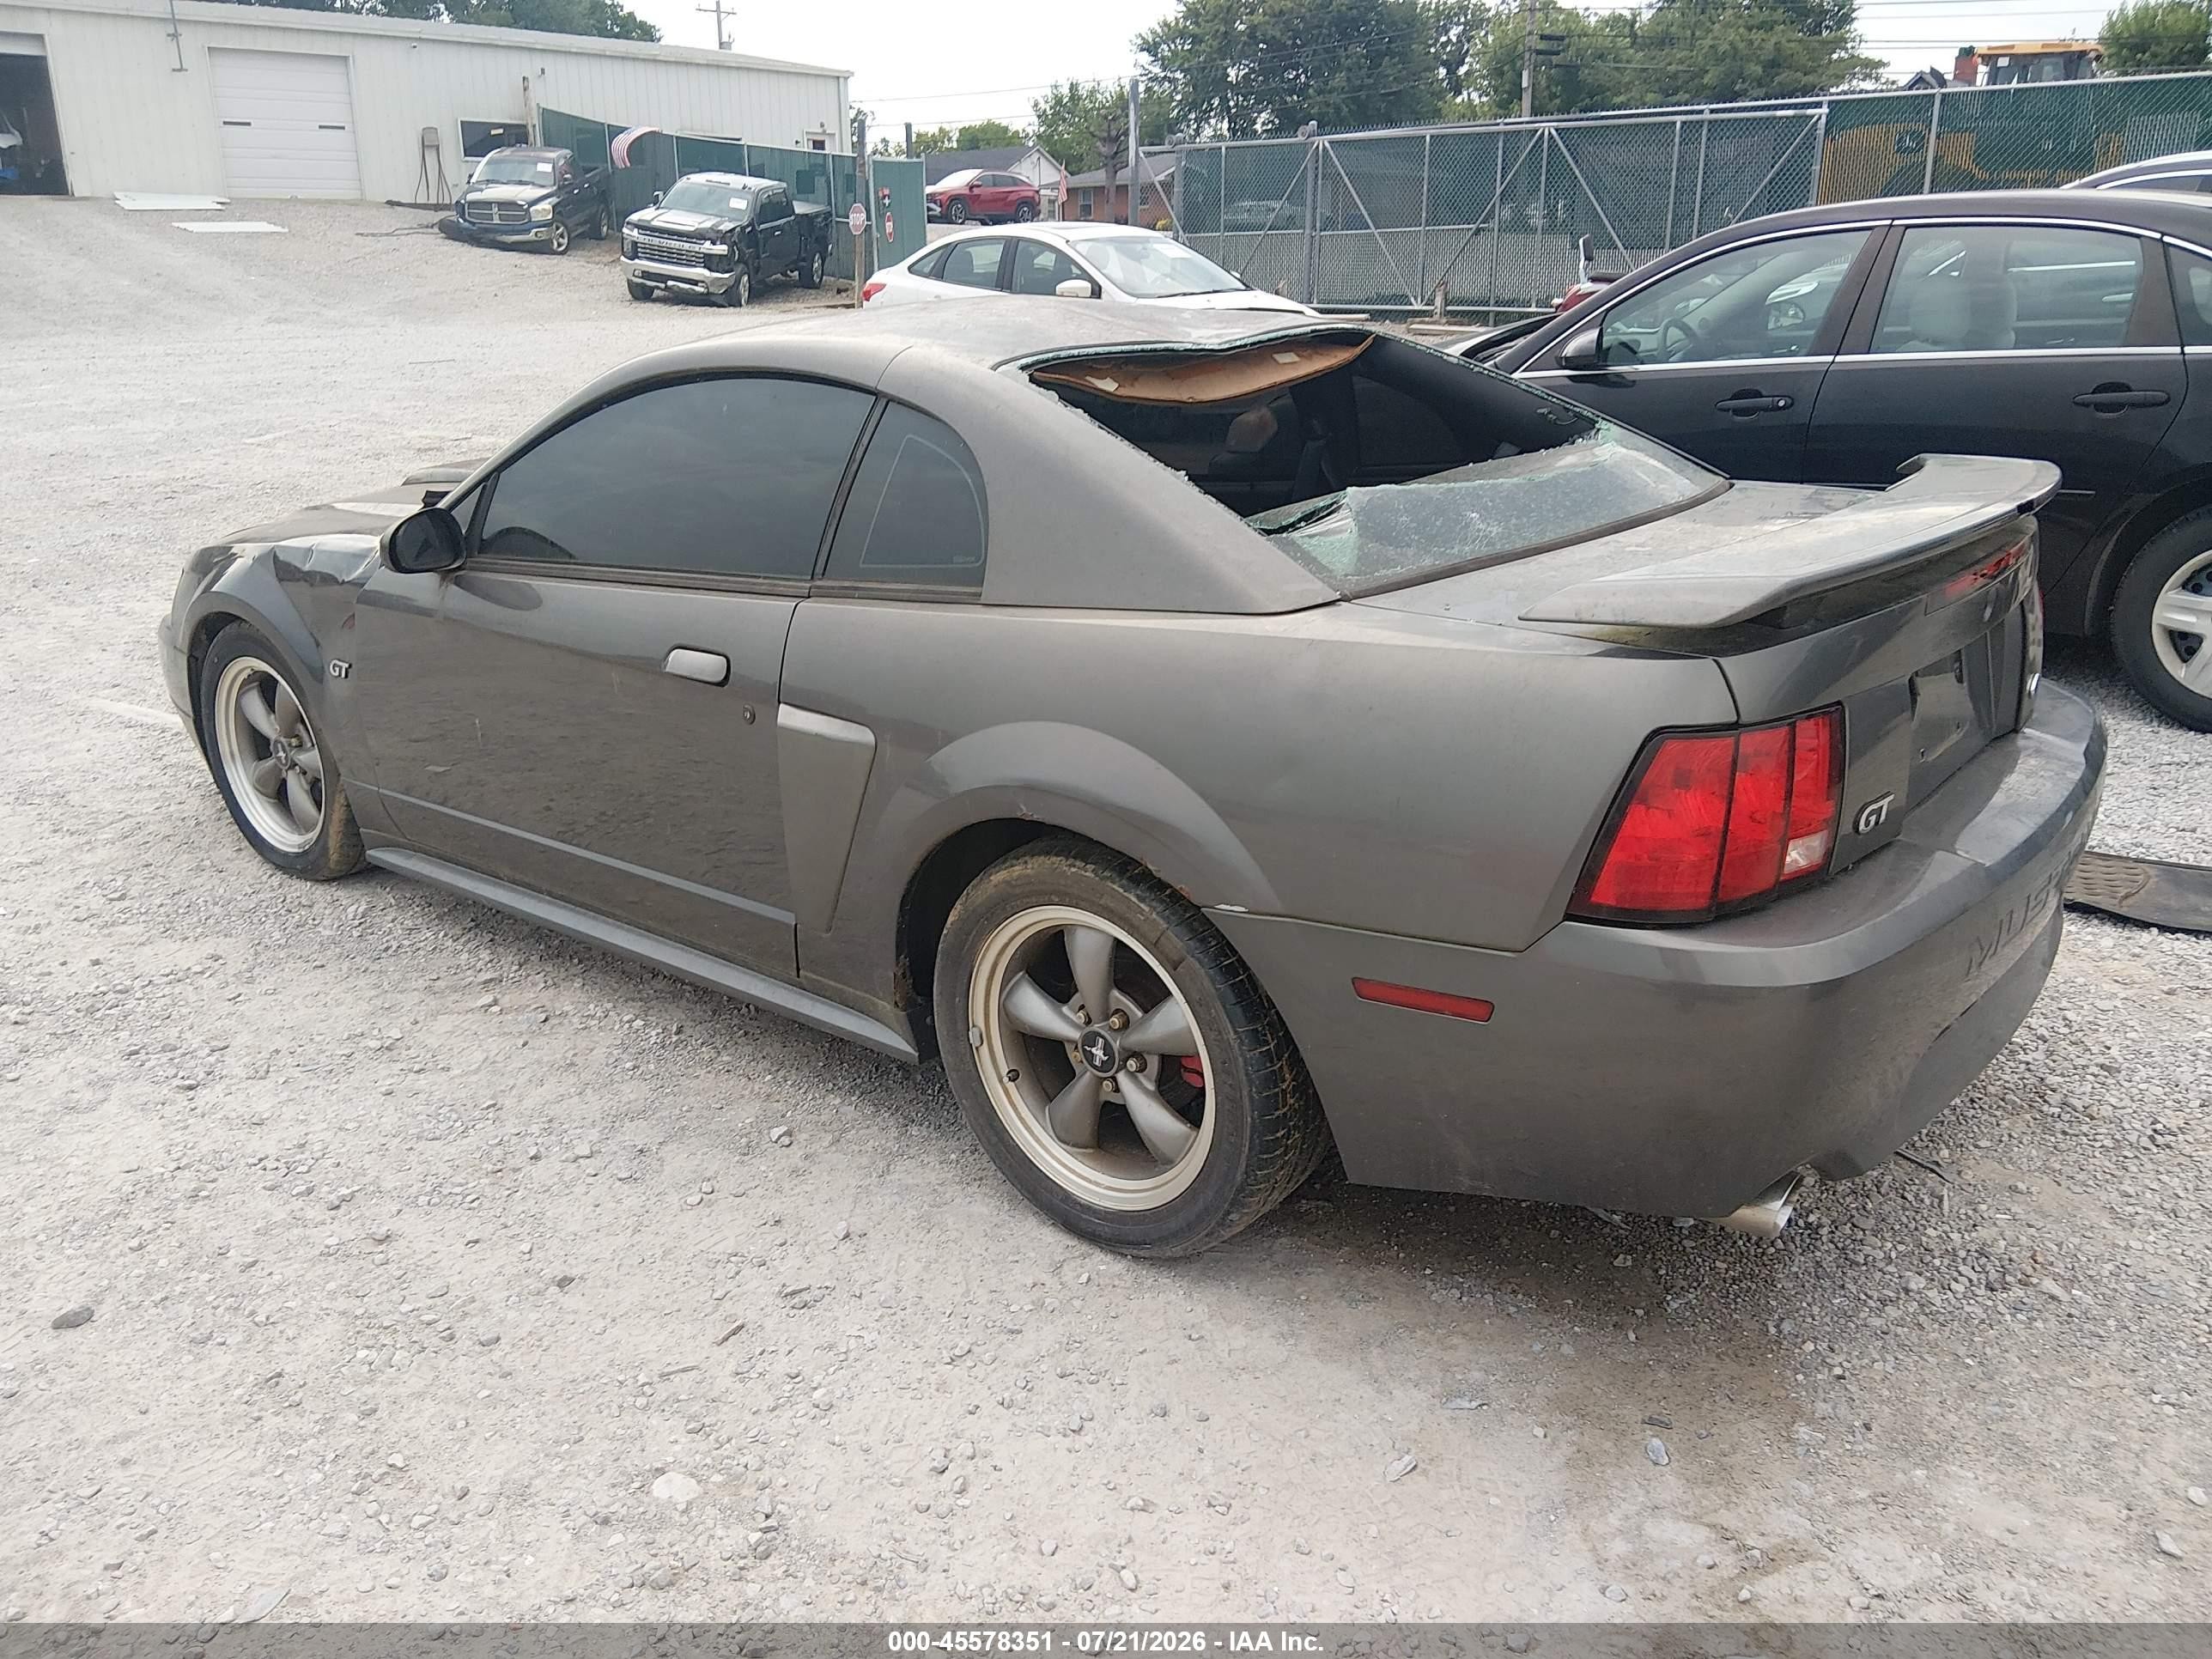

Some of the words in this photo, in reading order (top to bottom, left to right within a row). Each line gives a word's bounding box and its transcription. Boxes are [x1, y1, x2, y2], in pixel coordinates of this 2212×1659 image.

[850, 213, 865, 225] STOP
[330, 659, 350, 678] GT
[1858, 793, 1895, 834] GT
